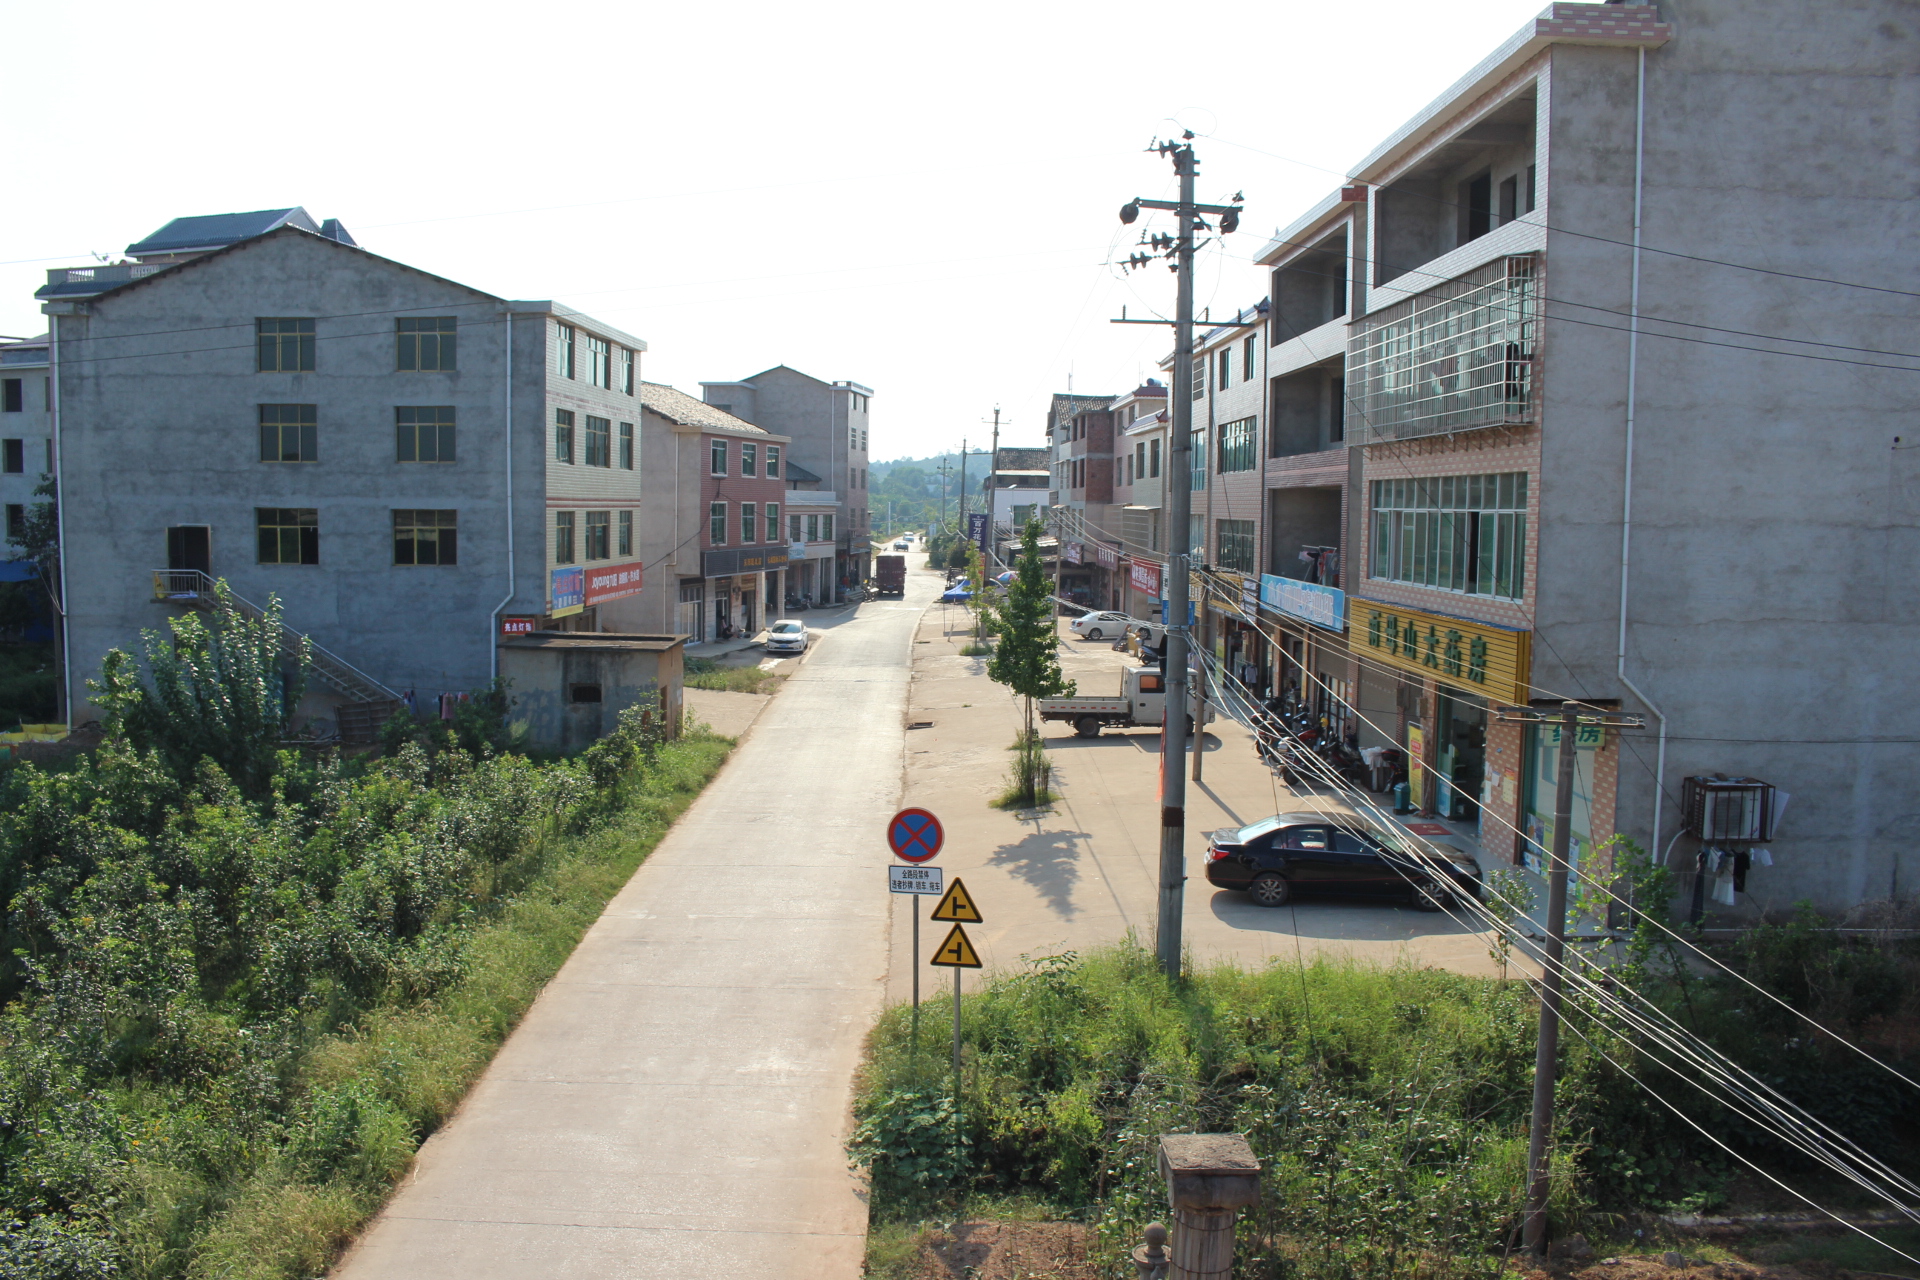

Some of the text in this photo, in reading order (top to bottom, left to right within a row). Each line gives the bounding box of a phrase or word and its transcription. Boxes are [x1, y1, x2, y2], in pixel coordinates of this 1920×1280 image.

[902, 869, 929, 880] 全路段禁停
